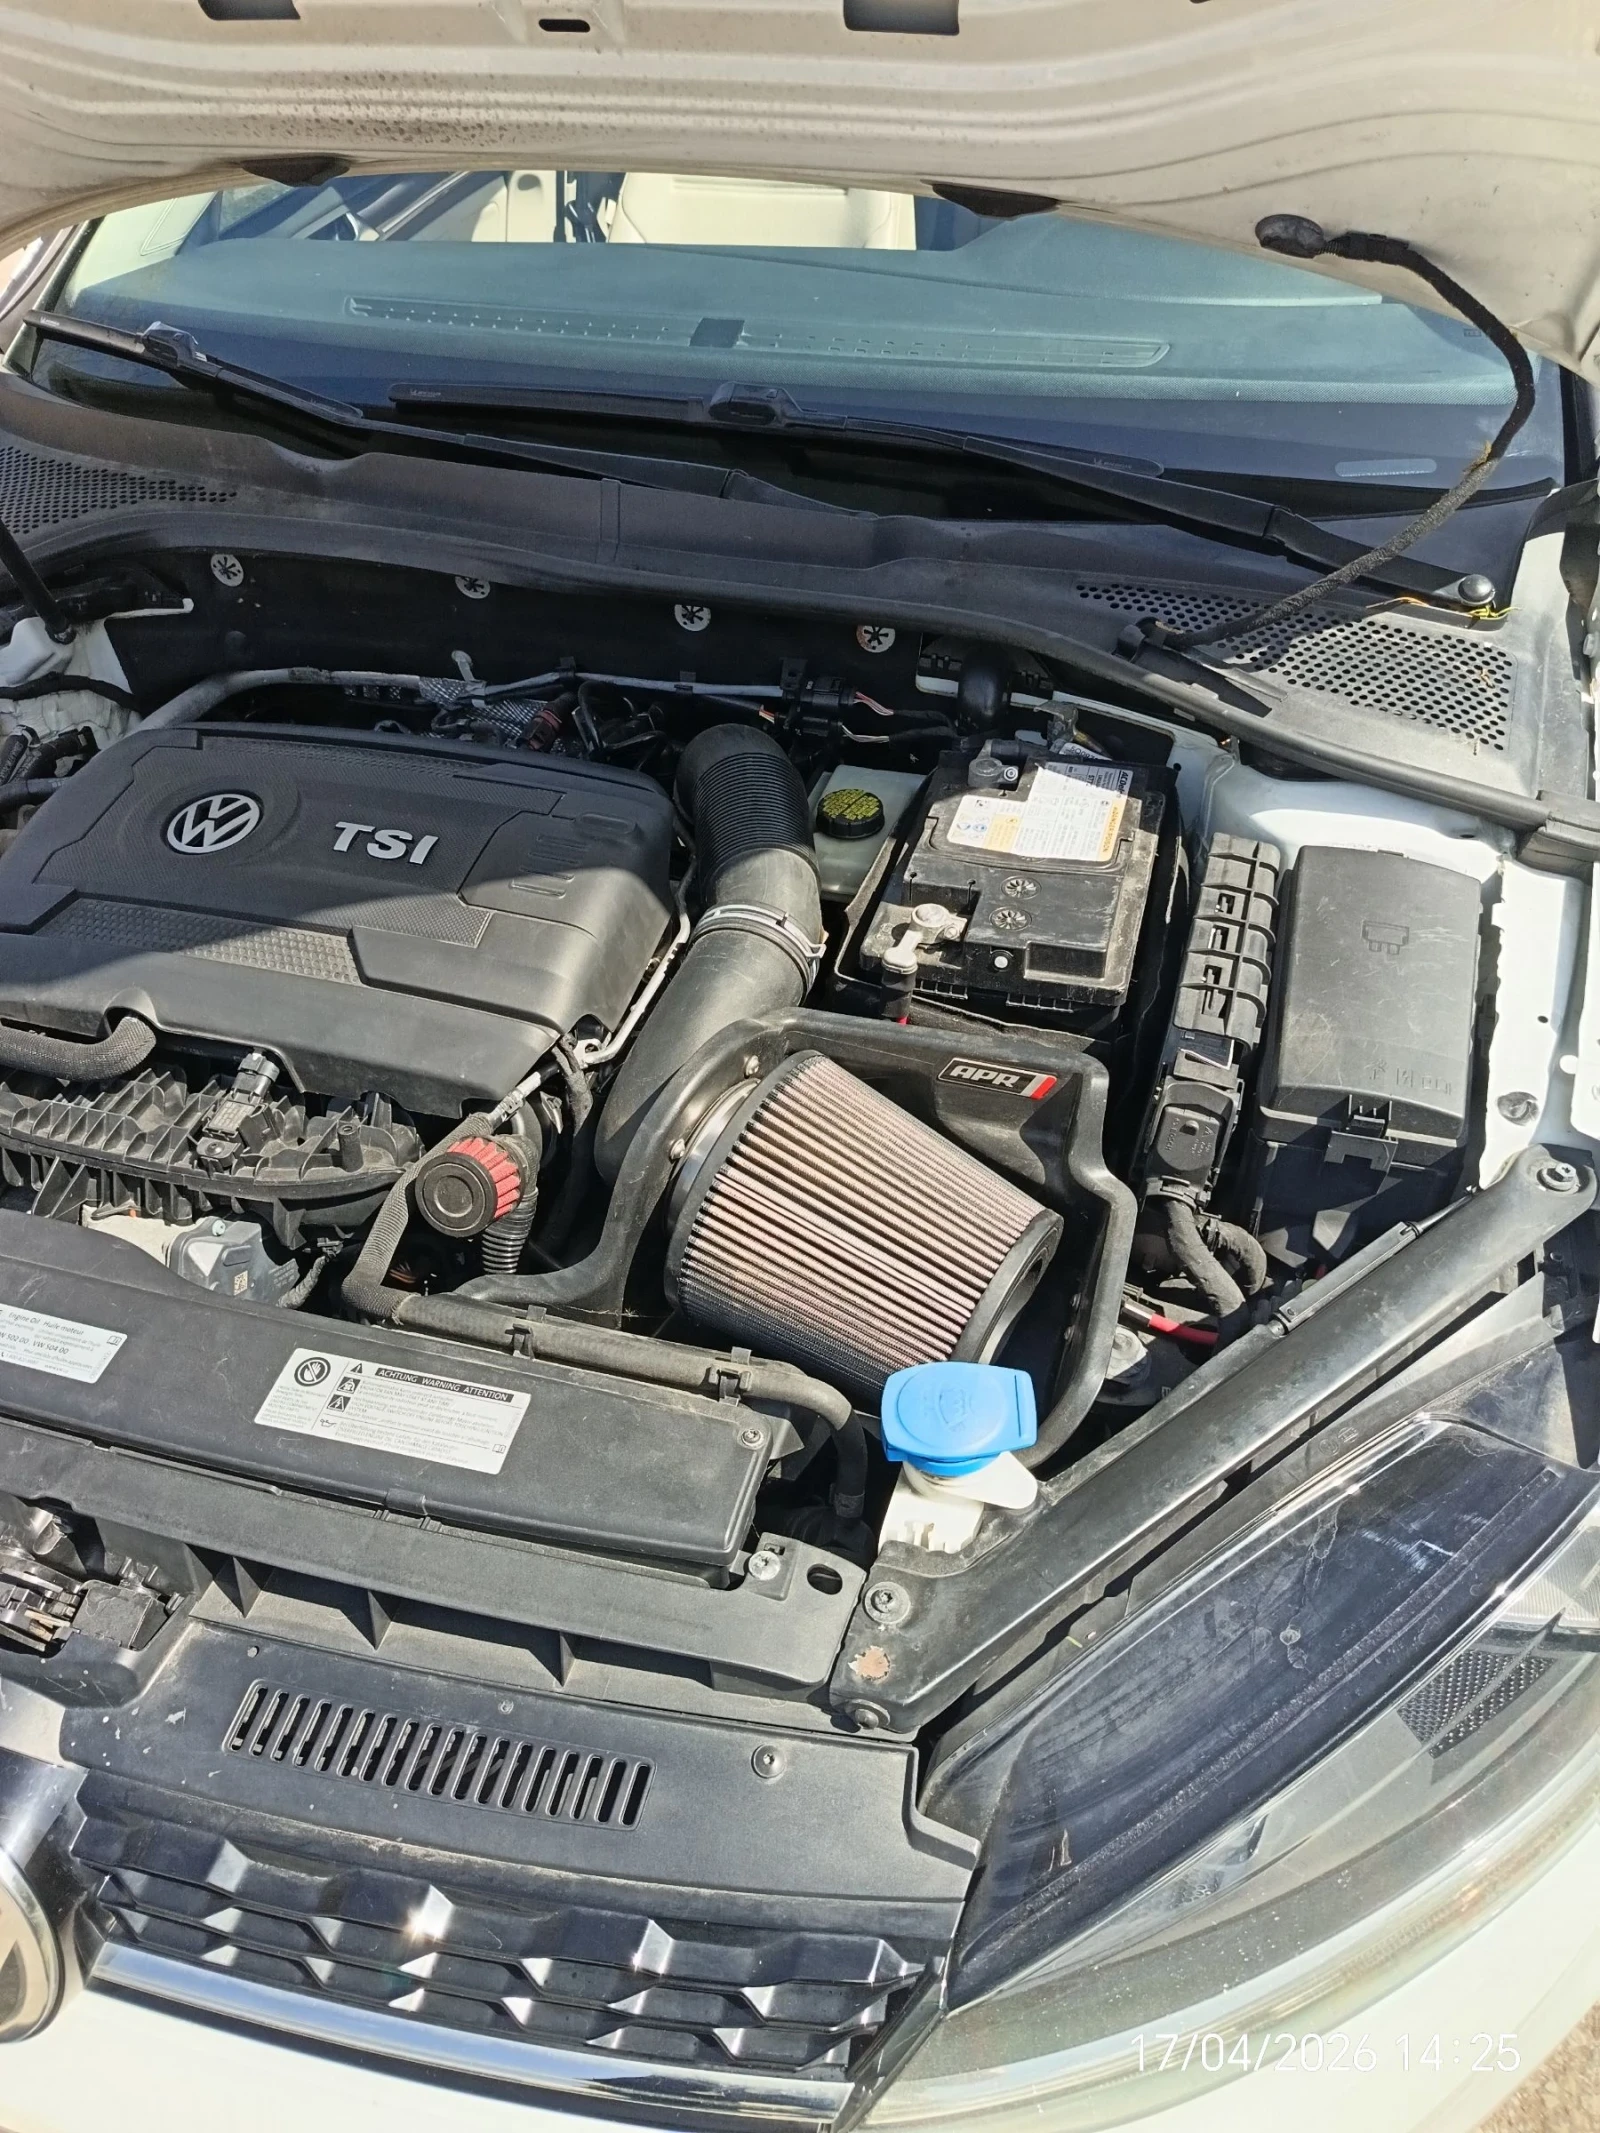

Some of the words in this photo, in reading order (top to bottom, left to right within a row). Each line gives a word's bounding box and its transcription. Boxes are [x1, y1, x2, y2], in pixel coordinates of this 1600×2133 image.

[334, 821, 439, 865] TSI
[949, 1065, 1020, 1088] APR
[9, 1312, 30, 1323] Engine
[43, 1320, 60, 1330] Huile
[61, 1325, 85, 1336] moteur
[33, 1340, 46, 1349] VW
[378, 1369, 418, 1383] ACHTUNG
[421, 1378, 460, 1393] WARNING
[463, 1386, 509, 1401] ATTENTION
